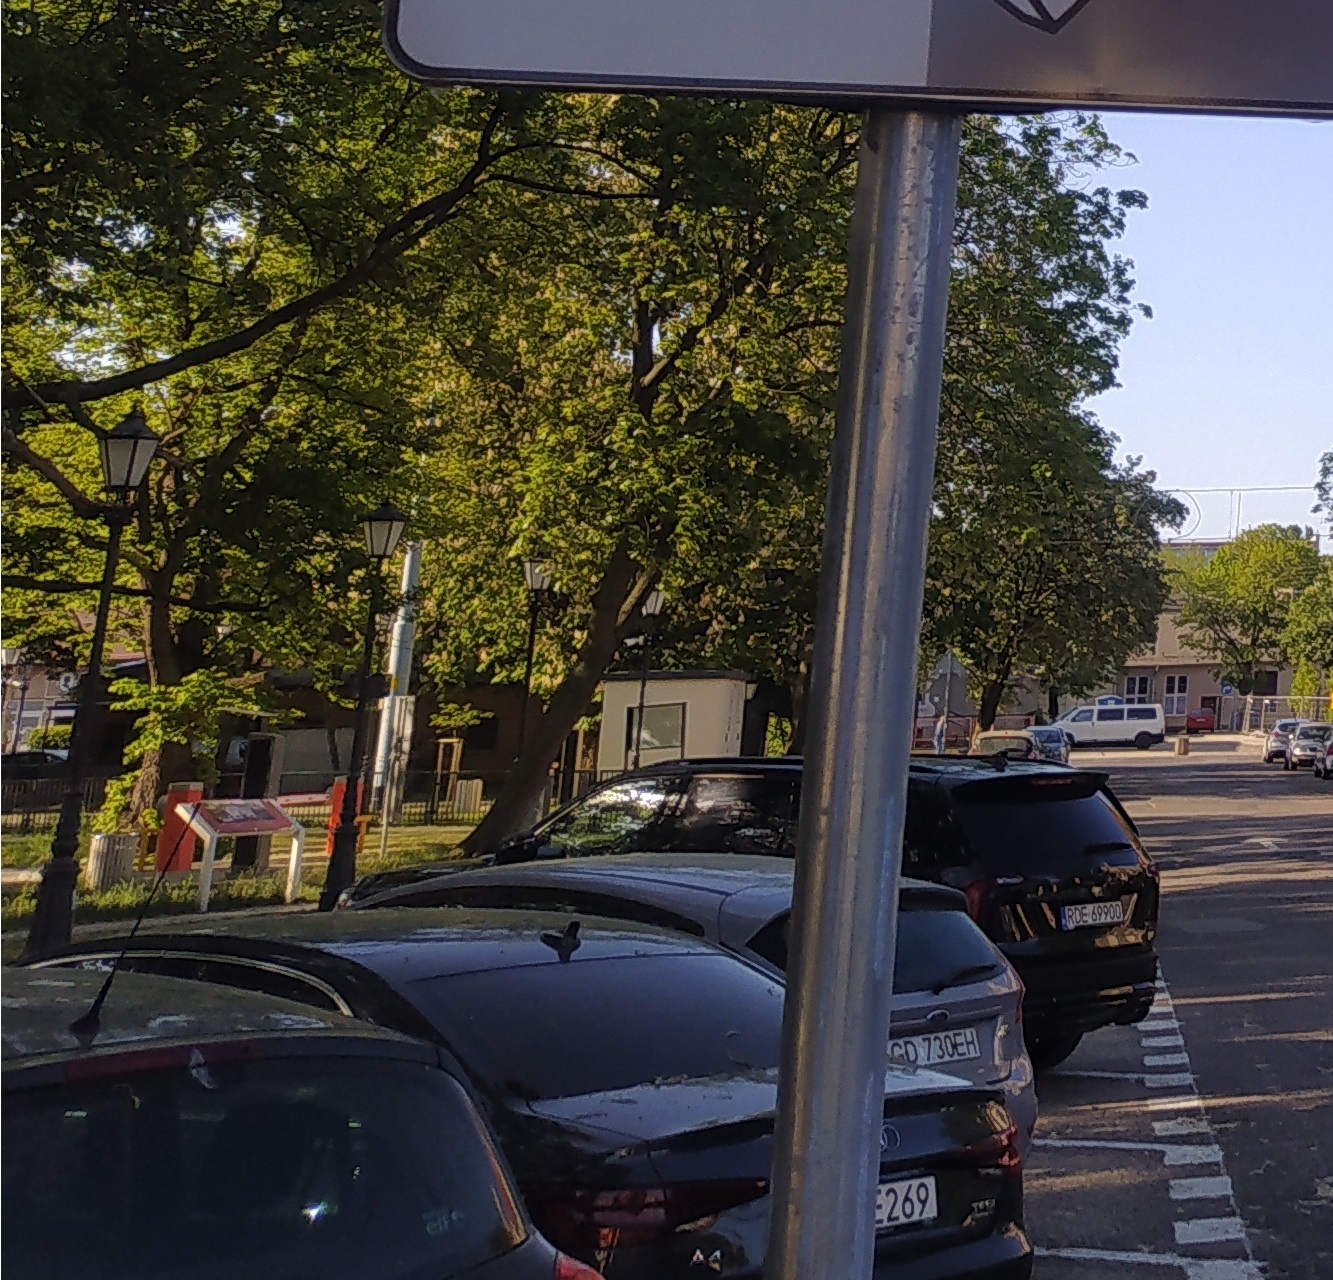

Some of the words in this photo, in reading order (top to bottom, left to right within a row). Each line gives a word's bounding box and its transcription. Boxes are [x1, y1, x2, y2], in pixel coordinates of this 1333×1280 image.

[1067, 906, 1089, 925] RDE
[1091, 903, 1121, 923] 69900
[891, 1039, 919, 1065] GD
[921, 1030, 978, 1062] 730EH
